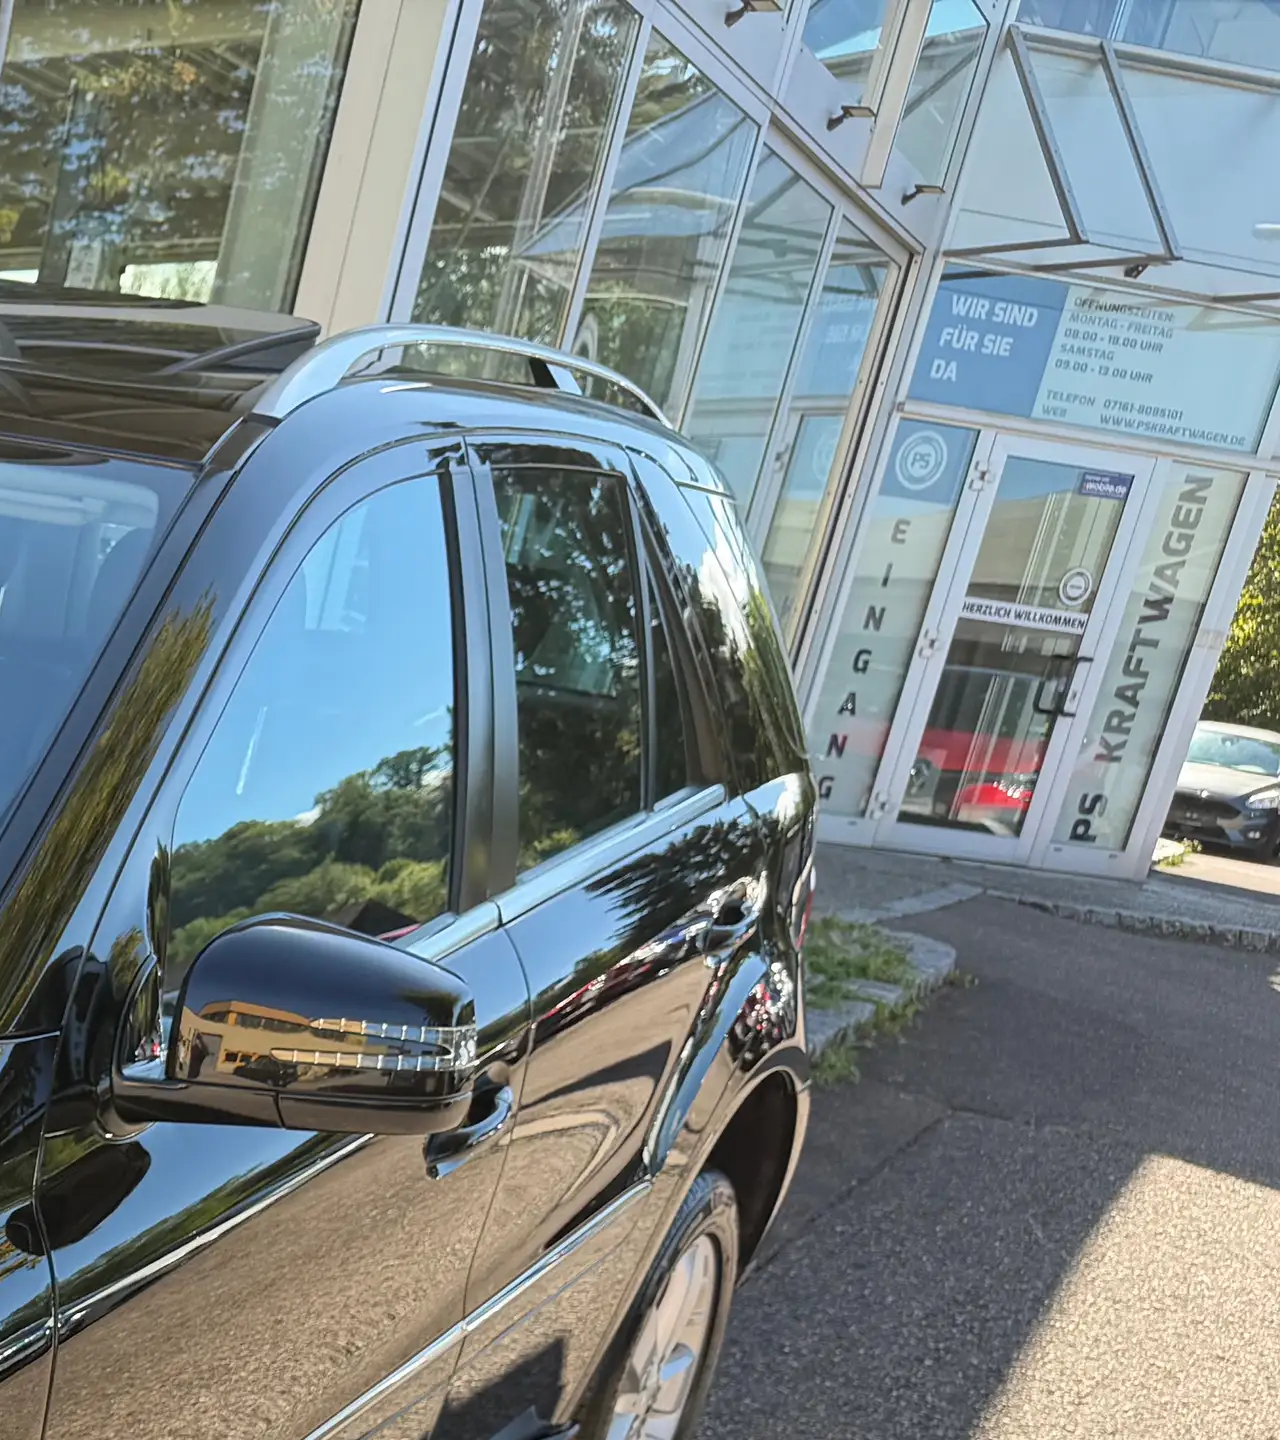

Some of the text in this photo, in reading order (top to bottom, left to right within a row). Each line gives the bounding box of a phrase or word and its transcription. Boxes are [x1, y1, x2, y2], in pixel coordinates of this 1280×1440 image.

[952, 294, 1038, 328] WIR SIND
[1069, 313, 1118, 330] MONTAG
[1127, 322, 1174, 339] FREITAG
[939, 323, 1014, 357] FÜR SIE
[1060, 343, 1115, 361] SAMSTAG
[1064, 328, 1097, 343] 08.00
[1140, 340, 1164, 354] UHR
[930, 358, 958, 382] DA
[1055, 358, 1088, 374] 09.00
[1129, 372, 1153, 385] UHR
[1042, 405, 1067, 418] WEB
[1046, 389, 1096, 408] TELEFON
[911, 452, 932, 470] PS
[962, 601, 1086, 630] HERZLICH WILLKOMMEN
[1069, 473, 1214, 843] PS KRAFTWAGEN
